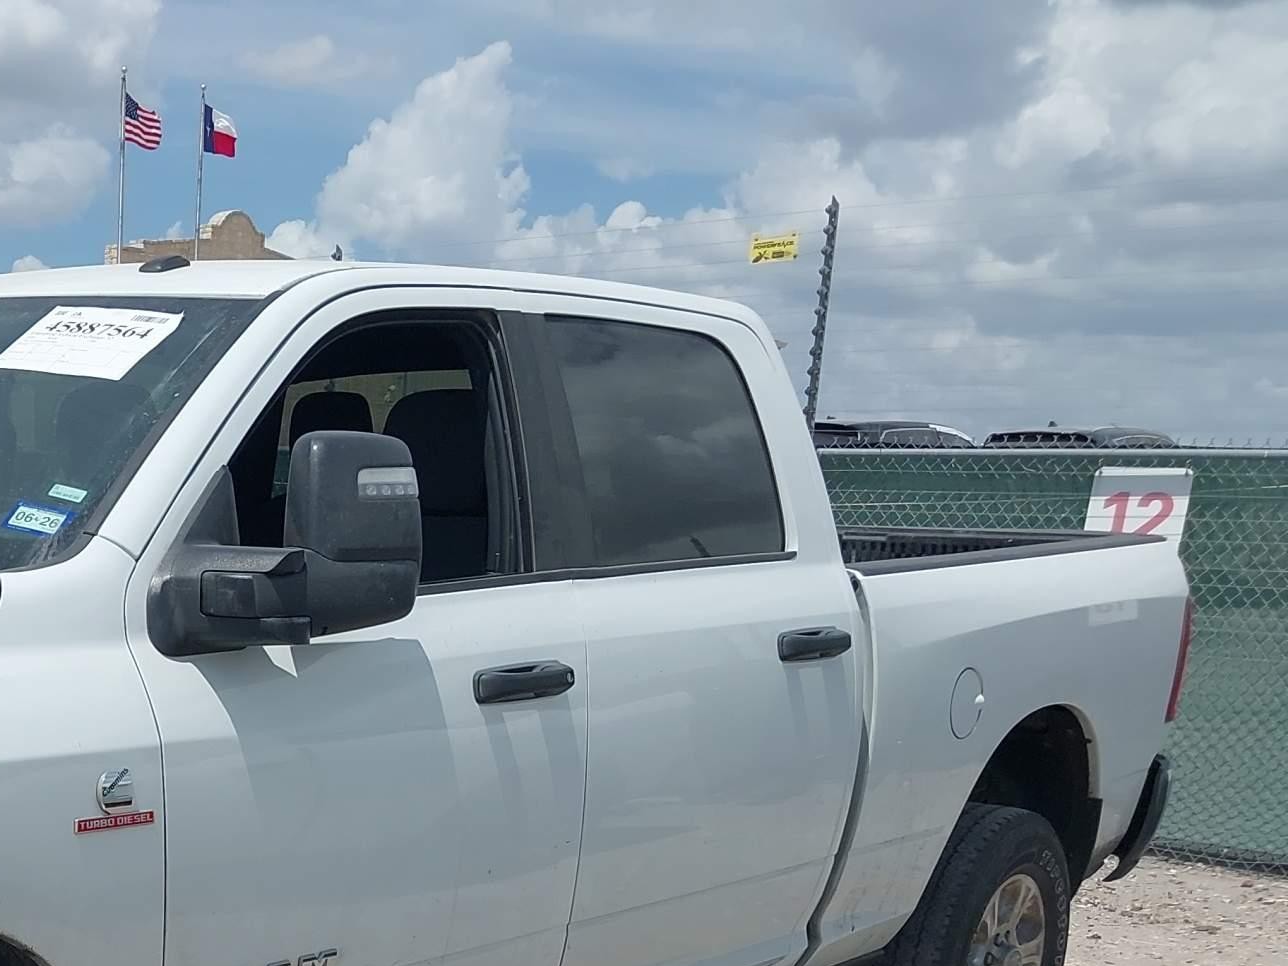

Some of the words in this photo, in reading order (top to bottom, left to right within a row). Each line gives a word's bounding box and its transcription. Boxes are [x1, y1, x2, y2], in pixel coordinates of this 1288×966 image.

[45, 319, 154, 340] 45887564
[1103, 491, 1174, 535] 12
[79, 817, 115, 830] TURBO
[117, 813, 153, 825] DIESEL
